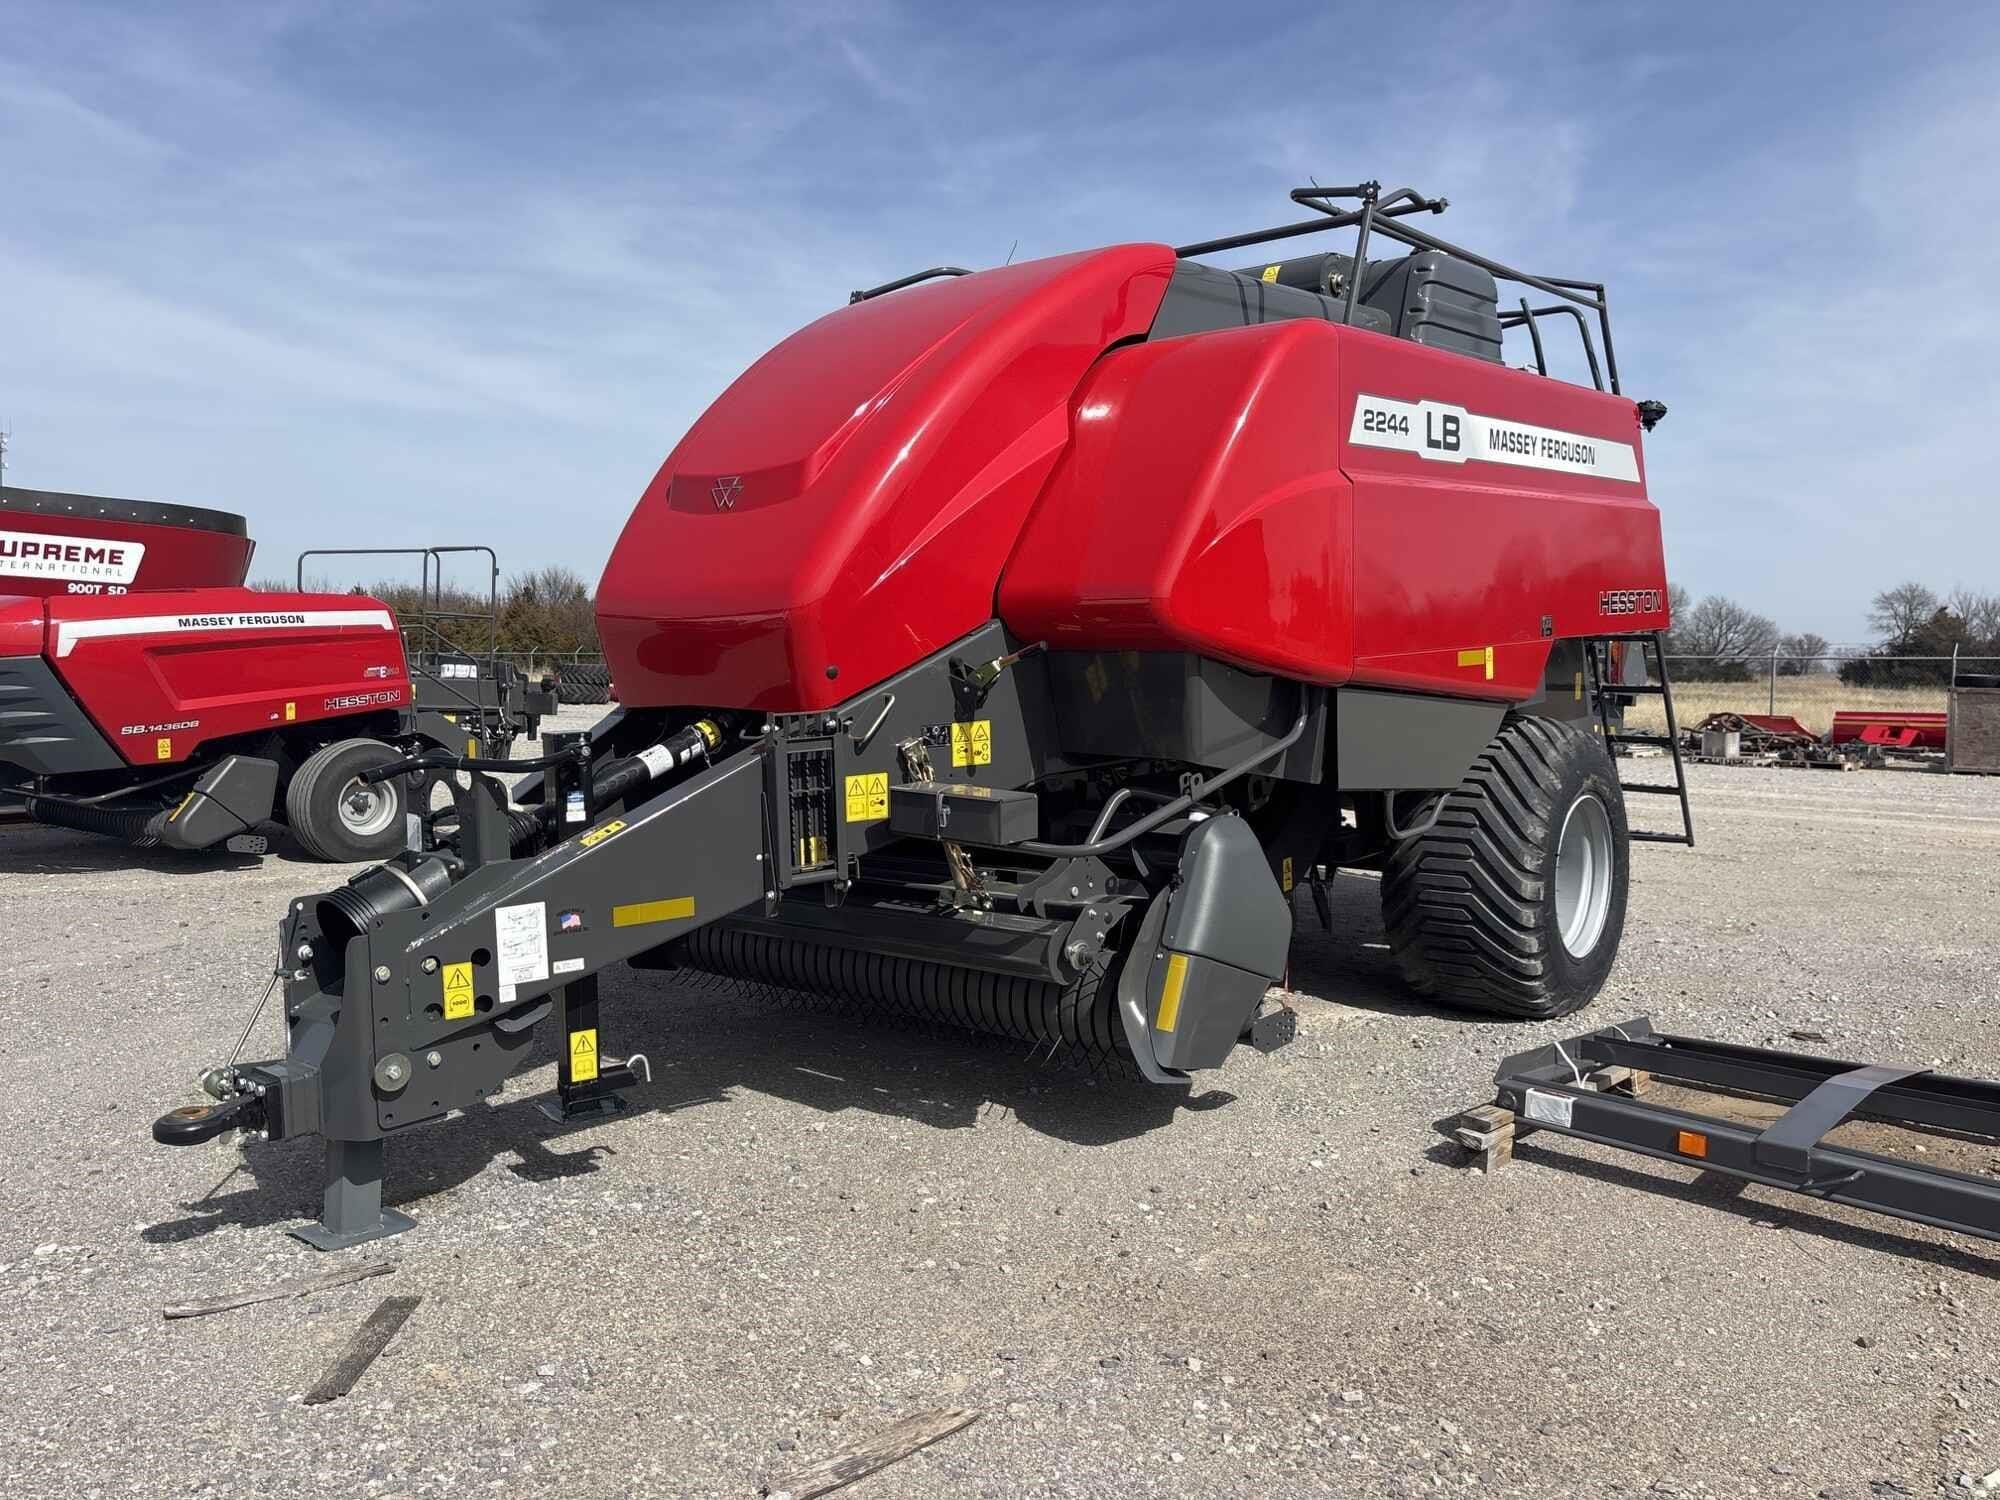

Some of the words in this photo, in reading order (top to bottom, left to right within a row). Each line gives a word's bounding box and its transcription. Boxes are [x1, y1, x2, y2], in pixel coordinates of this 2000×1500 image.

[1363, 408, 1410, 437] 2244
[1426, 411, 1462, 452] LB
[1489, 428, 1538, 456] MASSEY
[1541, 437, 1596, 465] FERGUSON
[0, 540, 125, 566] UPREME
[0, 559, 123, 577] TERNATIONAL
[67, 582, 103, 596] 900T
[107, 585, 128, 596] SD
[1599, 589, 1663, 616] HESSTON
[178, 616, 234, 628] MASSEY
[239, 613, 305, 625] FERGUSON
[324, 690, 401, 711] HESSTON
